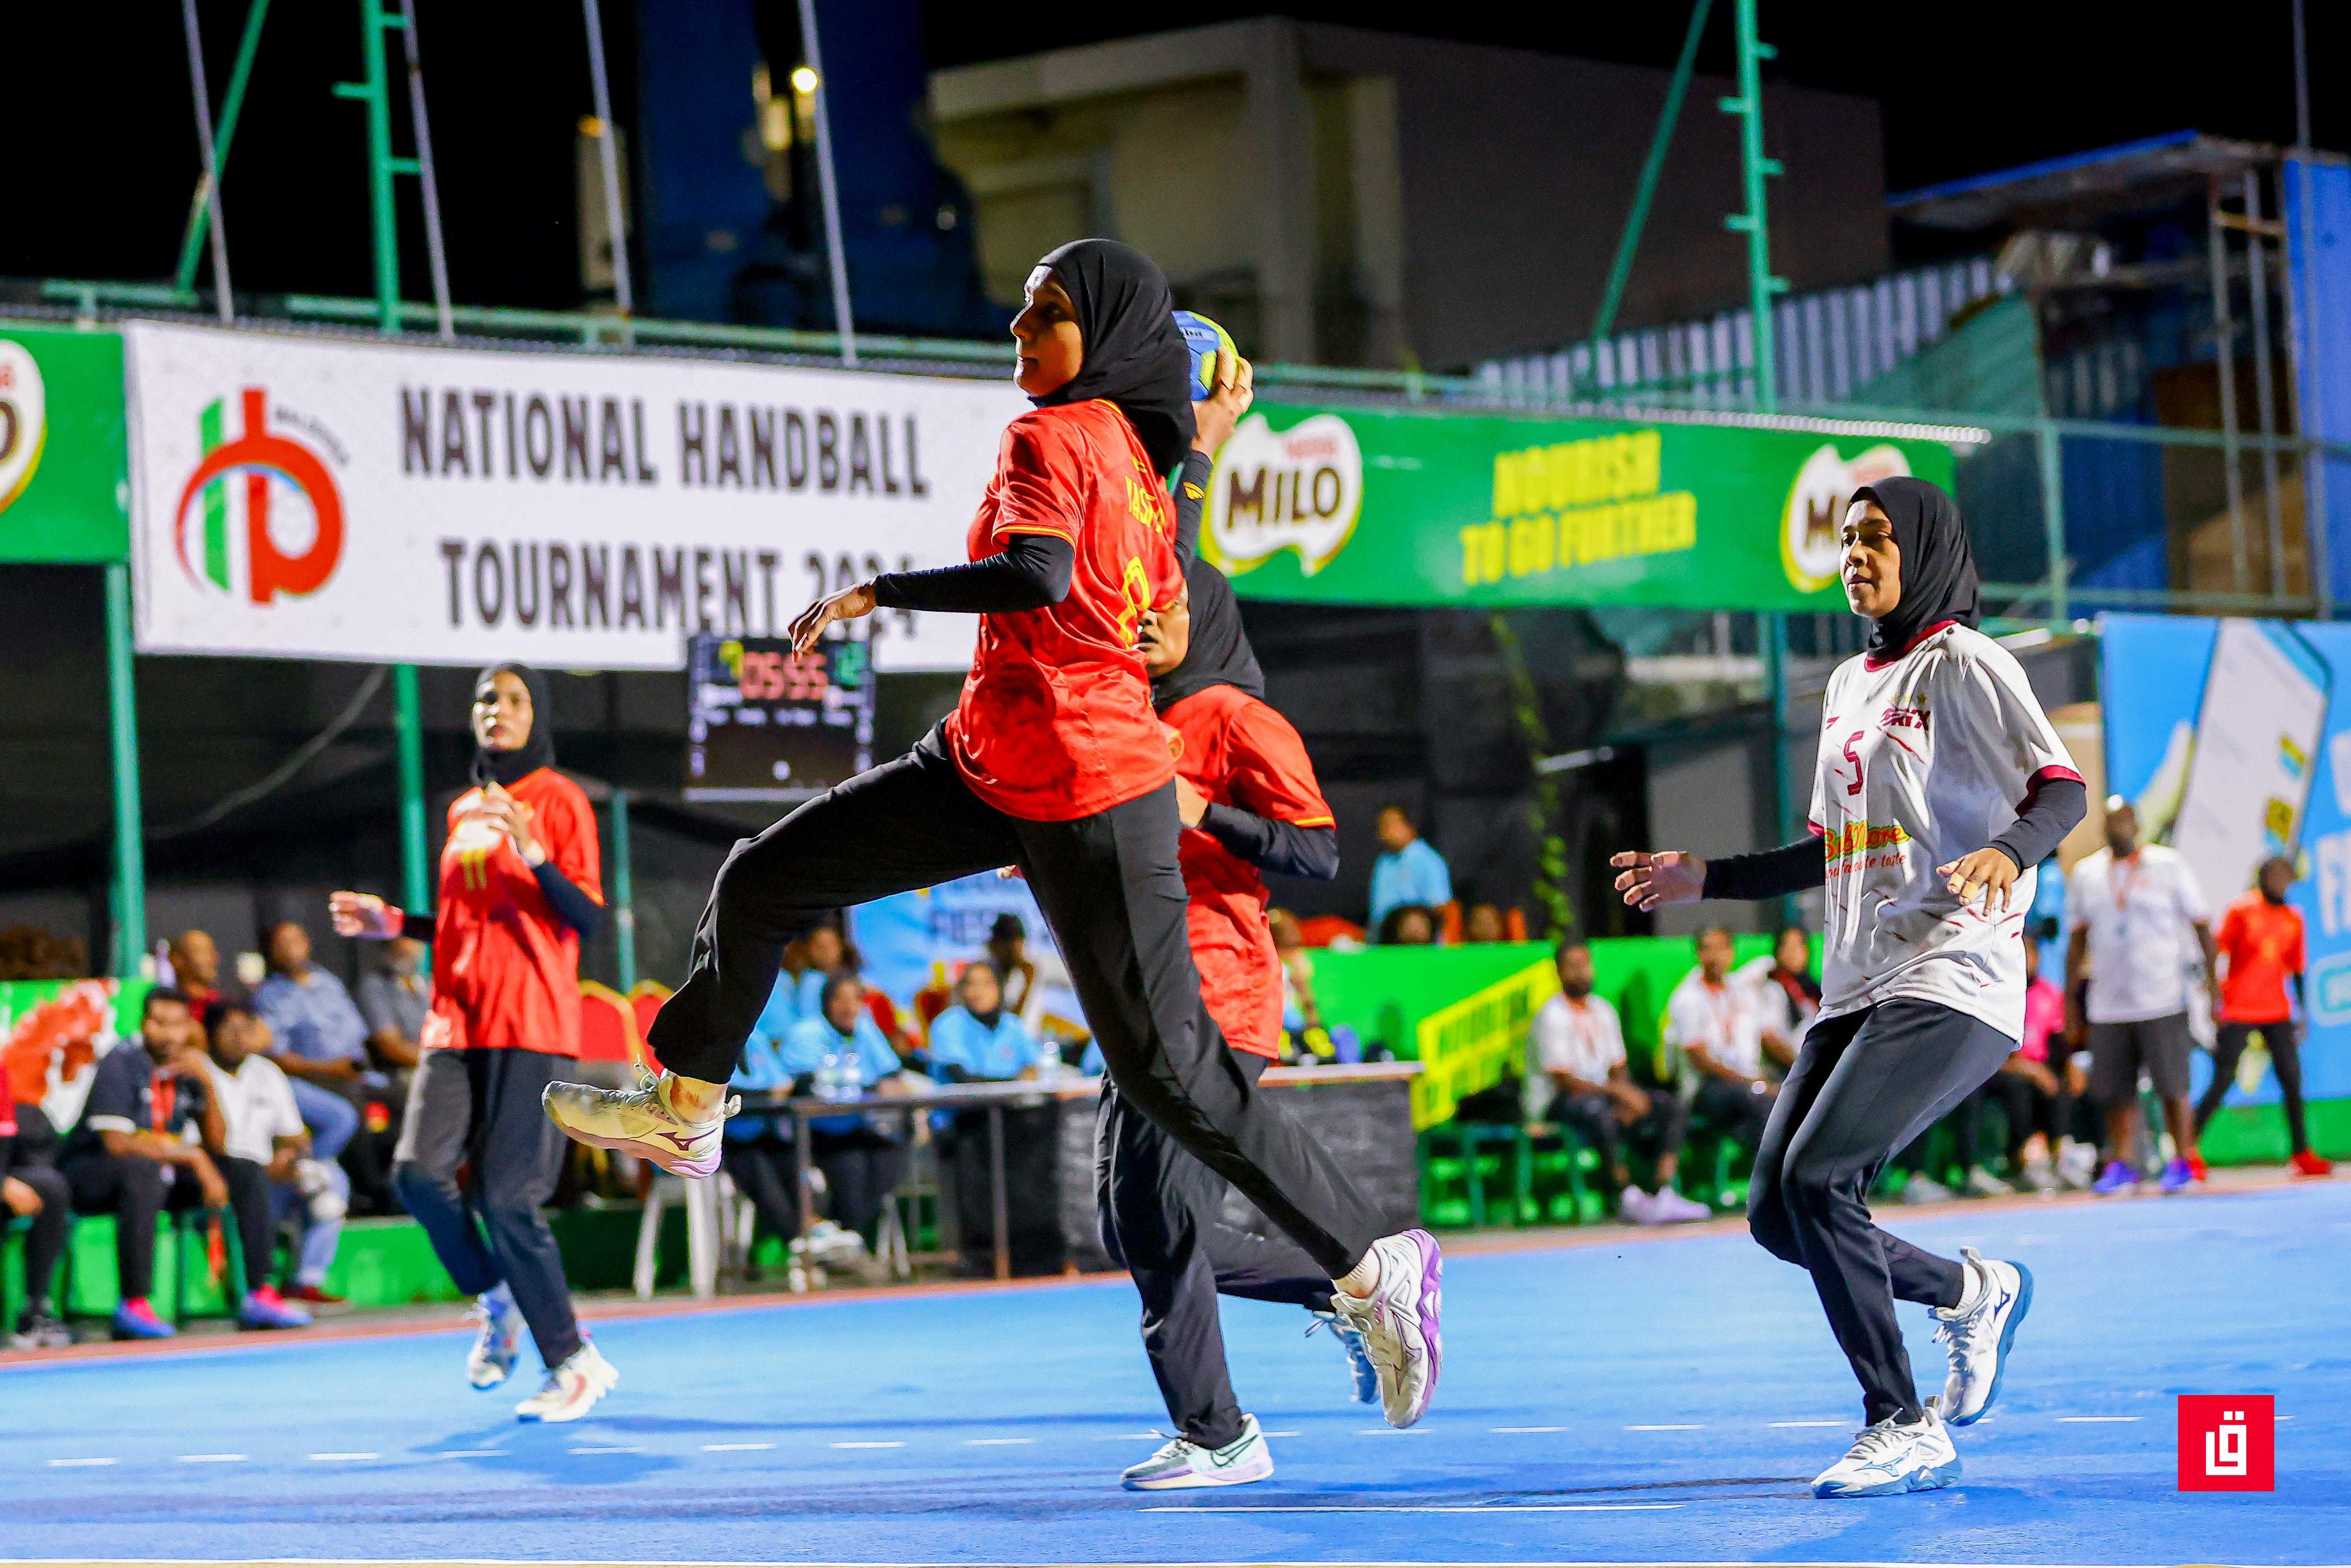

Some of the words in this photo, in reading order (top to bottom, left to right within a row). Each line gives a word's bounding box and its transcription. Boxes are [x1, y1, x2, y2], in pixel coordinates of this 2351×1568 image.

[402, 391, 654, 481] NATIONAL
[678, 403, 927, 495] HANDBALL
[1226, 467, 1341, 530] MILO
[441, 542, 779, 636] TOURNAMENT
[1843, 730, 1864, 796] 5
